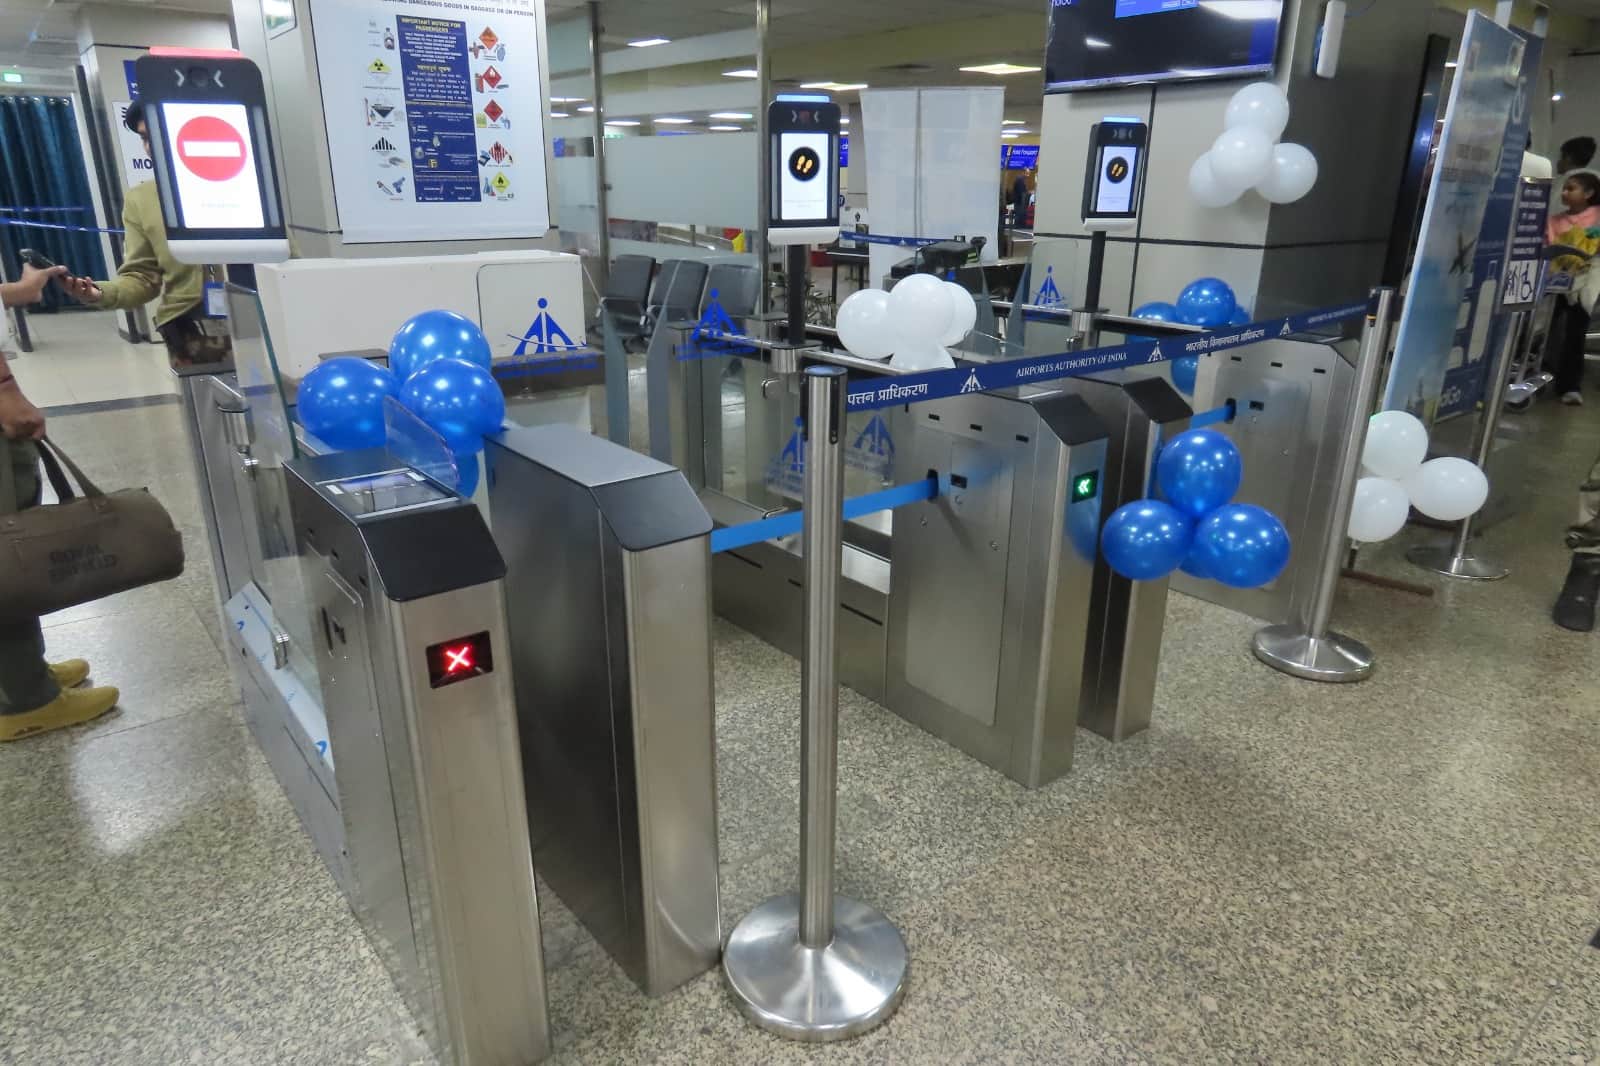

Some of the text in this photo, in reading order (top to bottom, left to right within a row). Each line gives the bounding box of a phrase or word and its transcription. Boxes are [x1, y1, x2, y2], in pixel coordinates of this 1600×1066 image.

[1016, 352, 1127, 378] AIRPORTS AUTHORITY OF INDIA
[878, 383, 929, 401] प्राधिकरण
